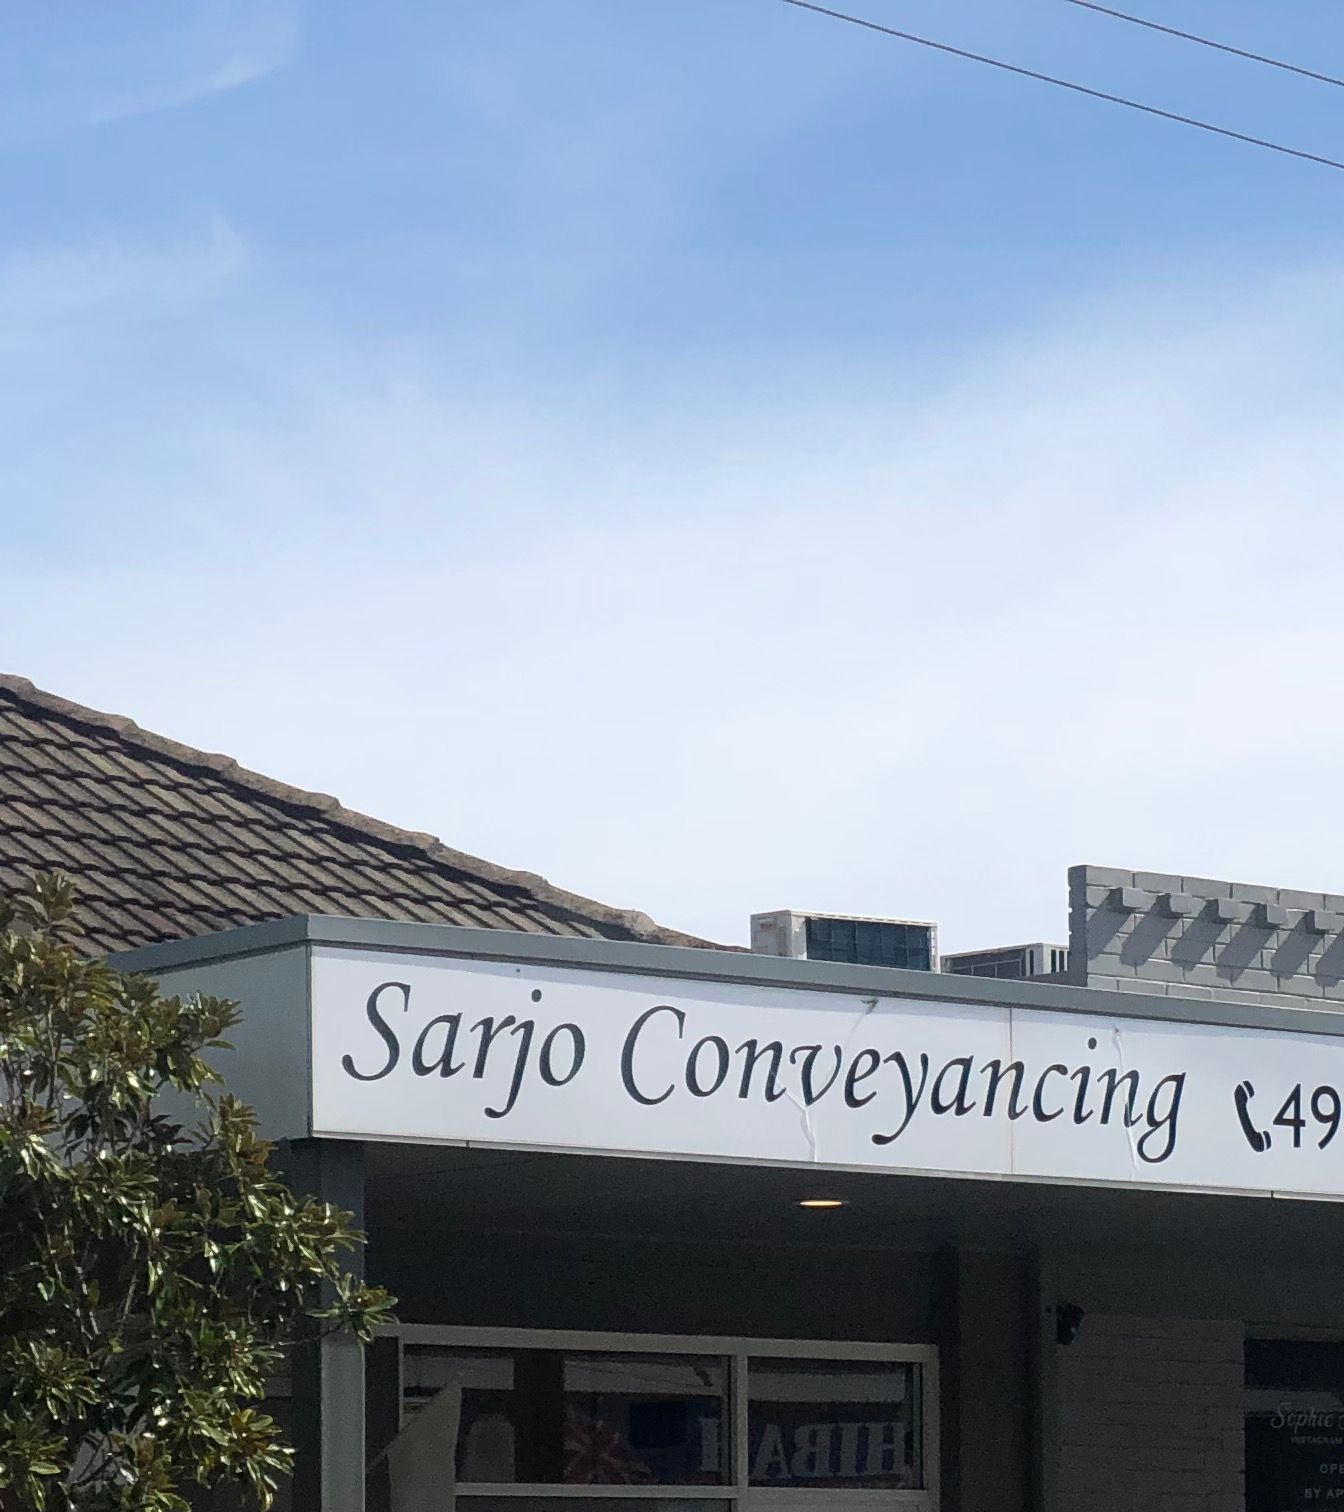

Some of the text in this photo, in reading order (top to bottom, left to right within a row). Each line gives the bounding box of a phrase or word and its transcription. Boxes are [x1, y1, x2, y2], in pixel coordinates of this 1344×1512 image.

[341, 981, 586, 1119] Sarjo
[620, 1004, 1187, 1163] Conveyancing
[1304, 1488, 1320, 1499] BY
